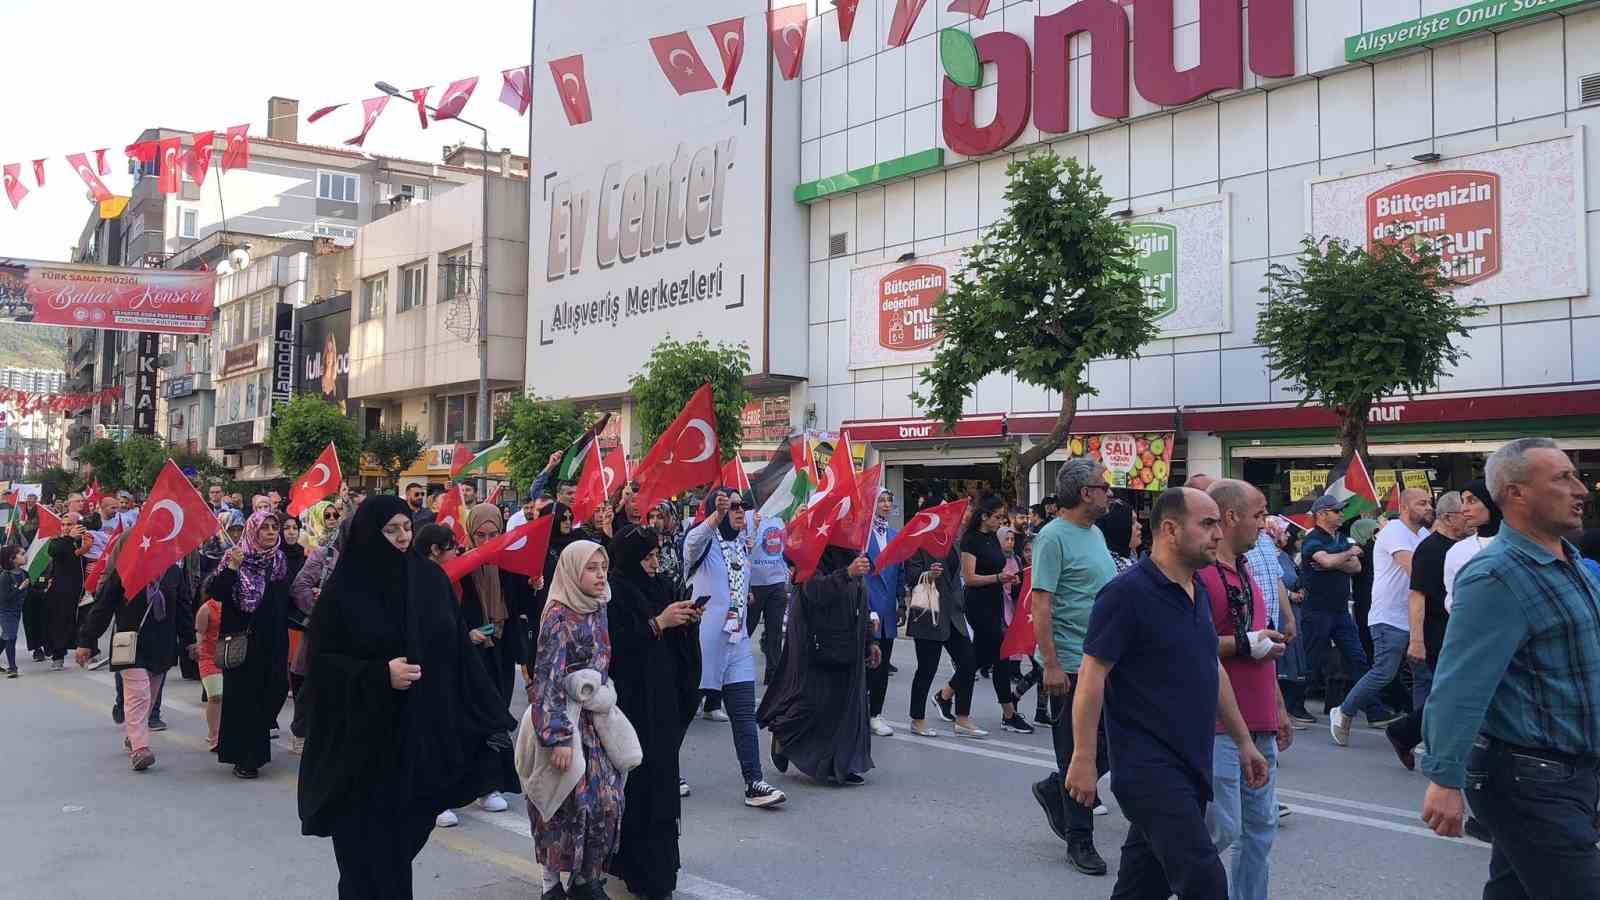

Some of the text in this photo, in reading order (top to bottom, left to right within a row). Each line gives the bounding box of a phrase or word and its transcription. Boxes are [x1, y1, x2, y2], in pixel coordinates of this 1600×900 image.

[1355, 15, 1450, 53] Alışverişte
[1456, 1, 1508, 26] Onur
[1376, 182, 1491, 217] Bütçenizin
[547, 136, 736, 282] Ev Center
[41, 272, 67, 281] TÜRK
[69, 274, 101, 284] SANAT
[884, 273, 942, 297] Bütçenizin
[551, 261, 723, 334] Alışveriş Merkezleri
[882, 294, 920, 312] değerini
[914, 323, 937, 340] bili
[1368, 405, 1405, 422] nur
[899, 425, 932, 438] onur
[1105, 442, 1133, 457] SALI
